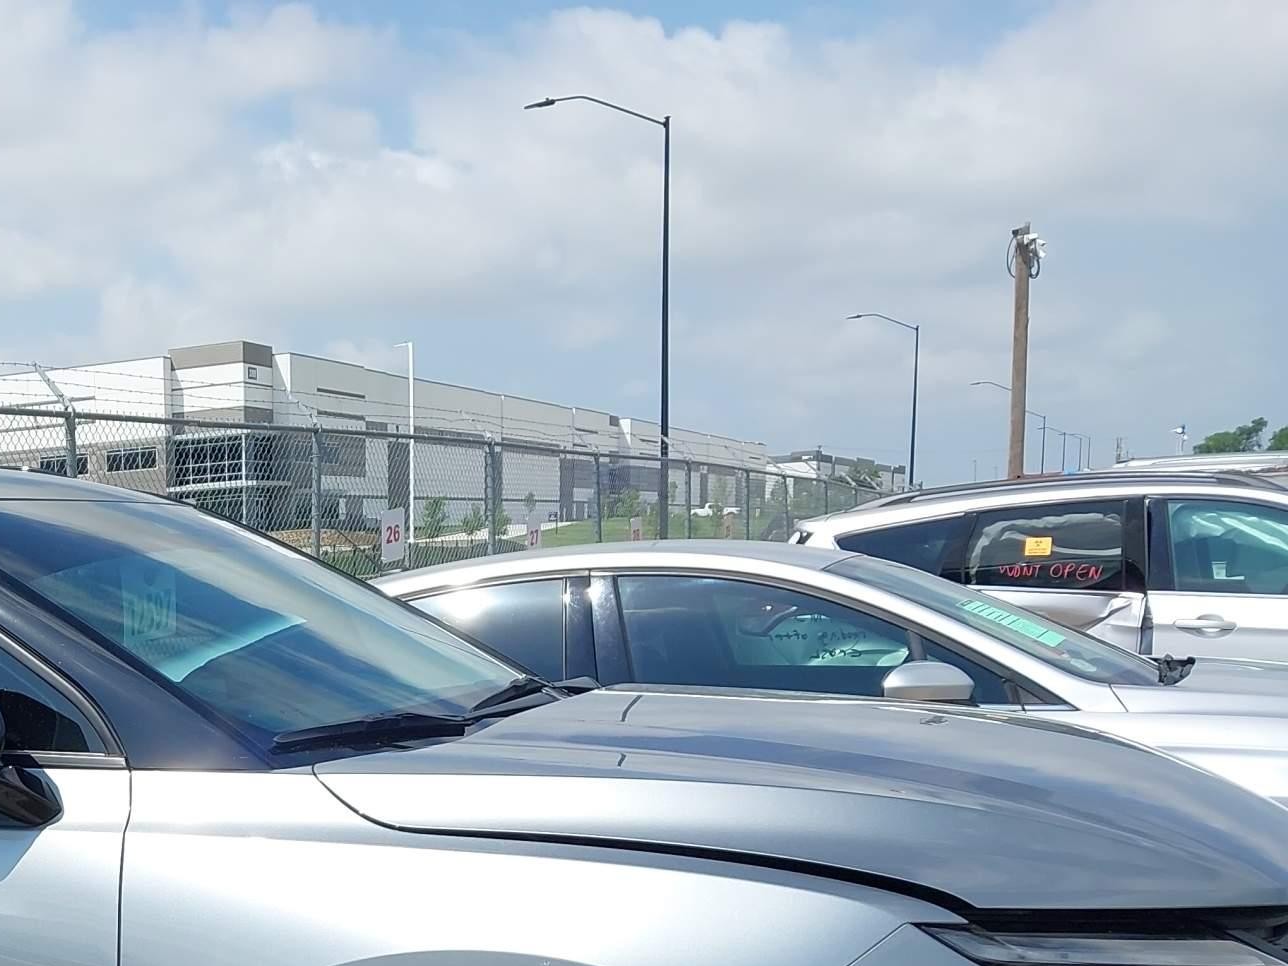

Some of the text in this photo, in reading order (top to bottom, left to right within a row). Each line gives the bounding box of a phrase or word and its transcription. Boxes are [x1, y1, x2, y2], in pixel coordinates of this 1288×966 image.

[385, 524, 401, 545] 26
[529, 528, 540, 546] 27
[999, 562, 1104, 581] WONT OPEN
